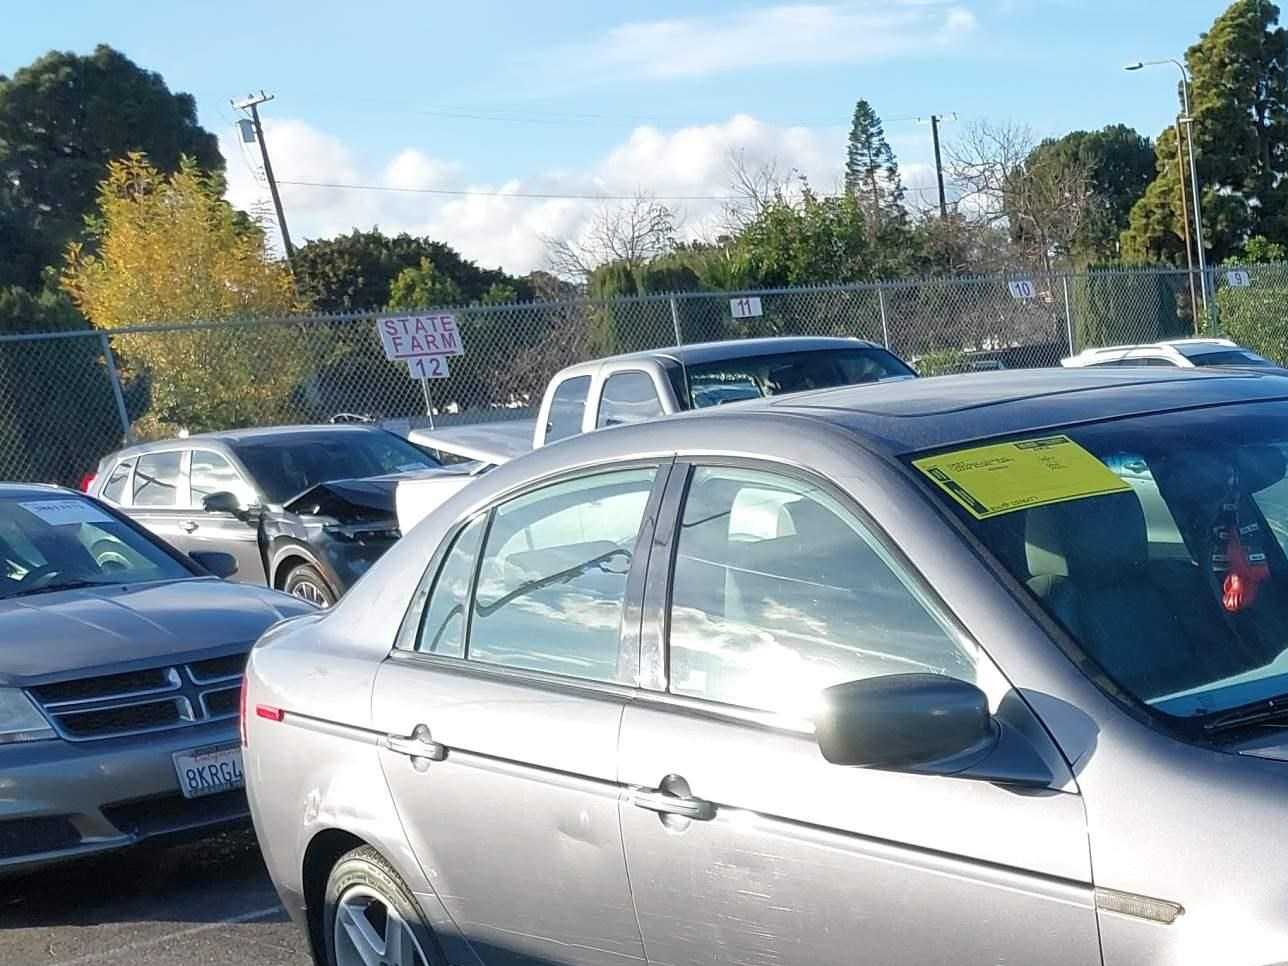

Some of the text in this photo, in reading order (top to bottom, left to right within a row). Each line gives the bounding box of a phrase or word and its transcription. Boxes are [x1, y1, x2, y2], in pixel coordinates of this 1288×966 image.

[1234, 273, 1242, 284] 9
[1015, 282, 1031, 297] 10
[736, 299, 753, 315] 11
[384, 316, 454, 337] STATE
[391, 333, 457, 353] FARM
[415, 358, 443, 377] 12
